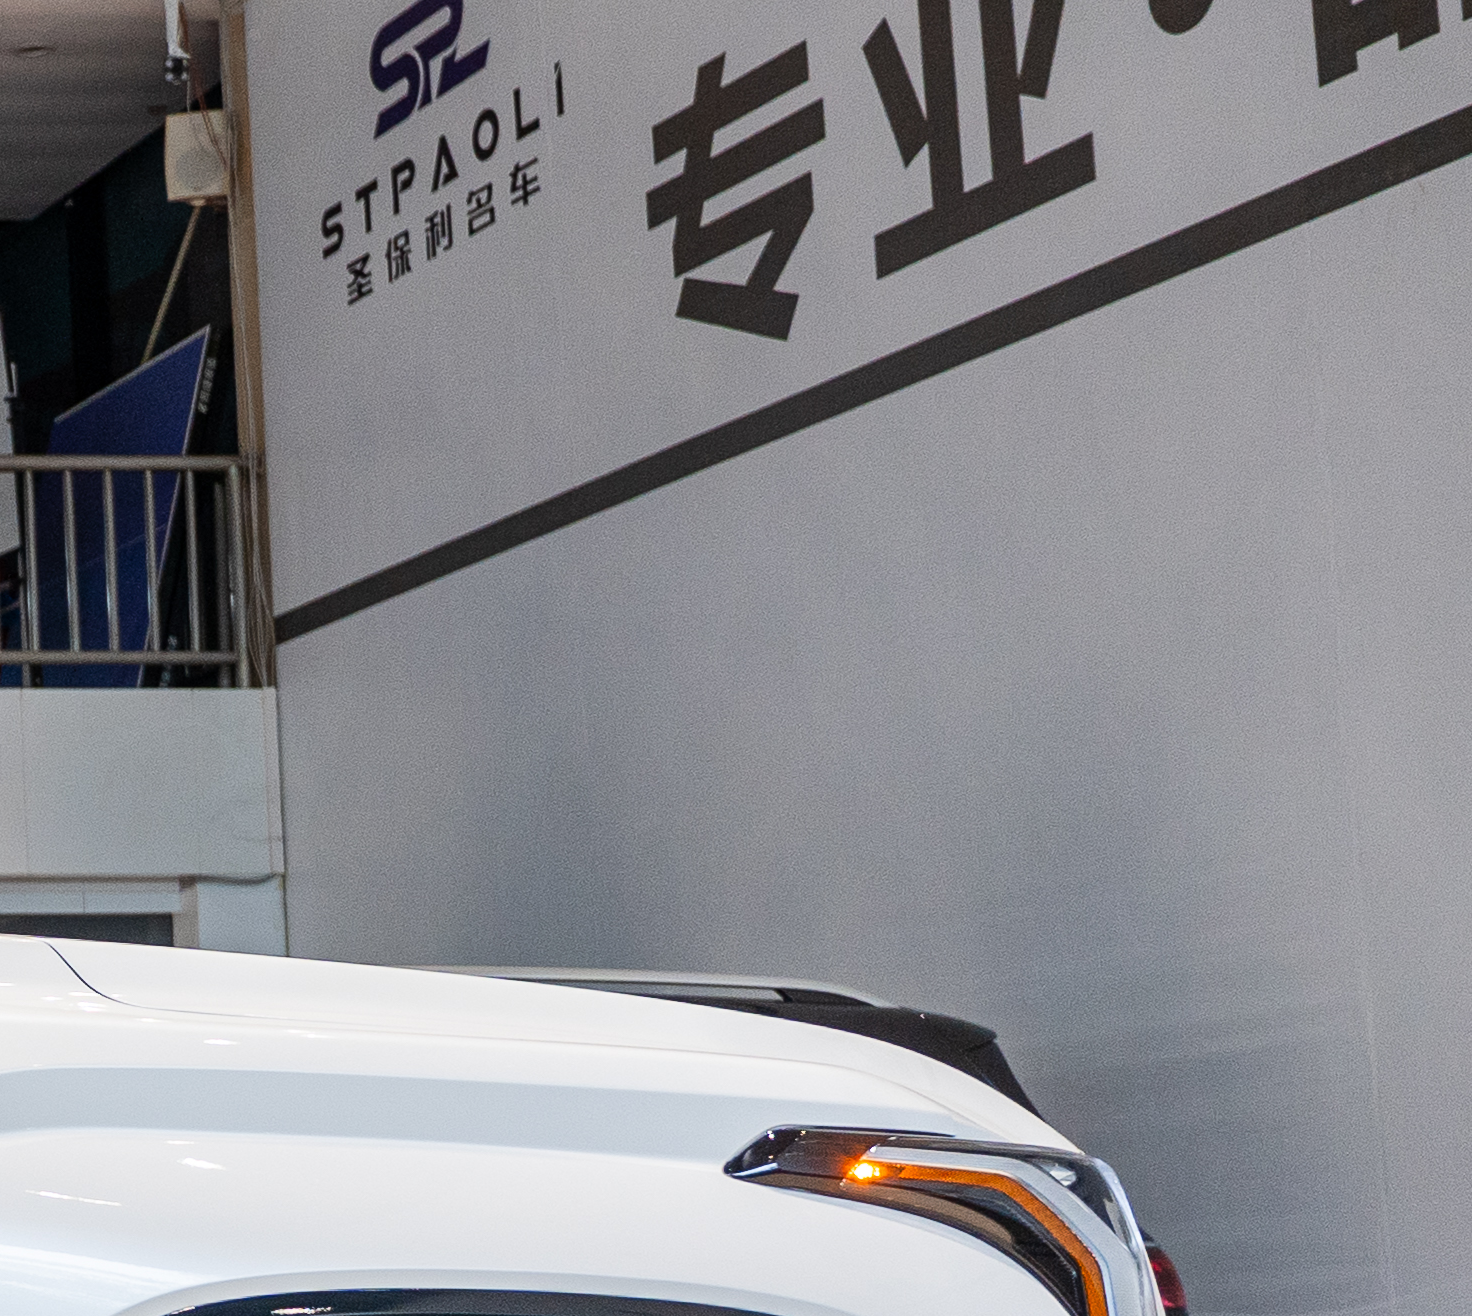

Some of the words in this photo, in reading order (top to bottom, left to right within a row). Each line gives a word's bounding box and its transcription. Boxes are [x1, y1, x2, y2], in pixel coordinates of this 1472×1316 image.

[321, 59, 564, 259] STPAOLI
[346, 156, 540, 305] 圣保利名车
